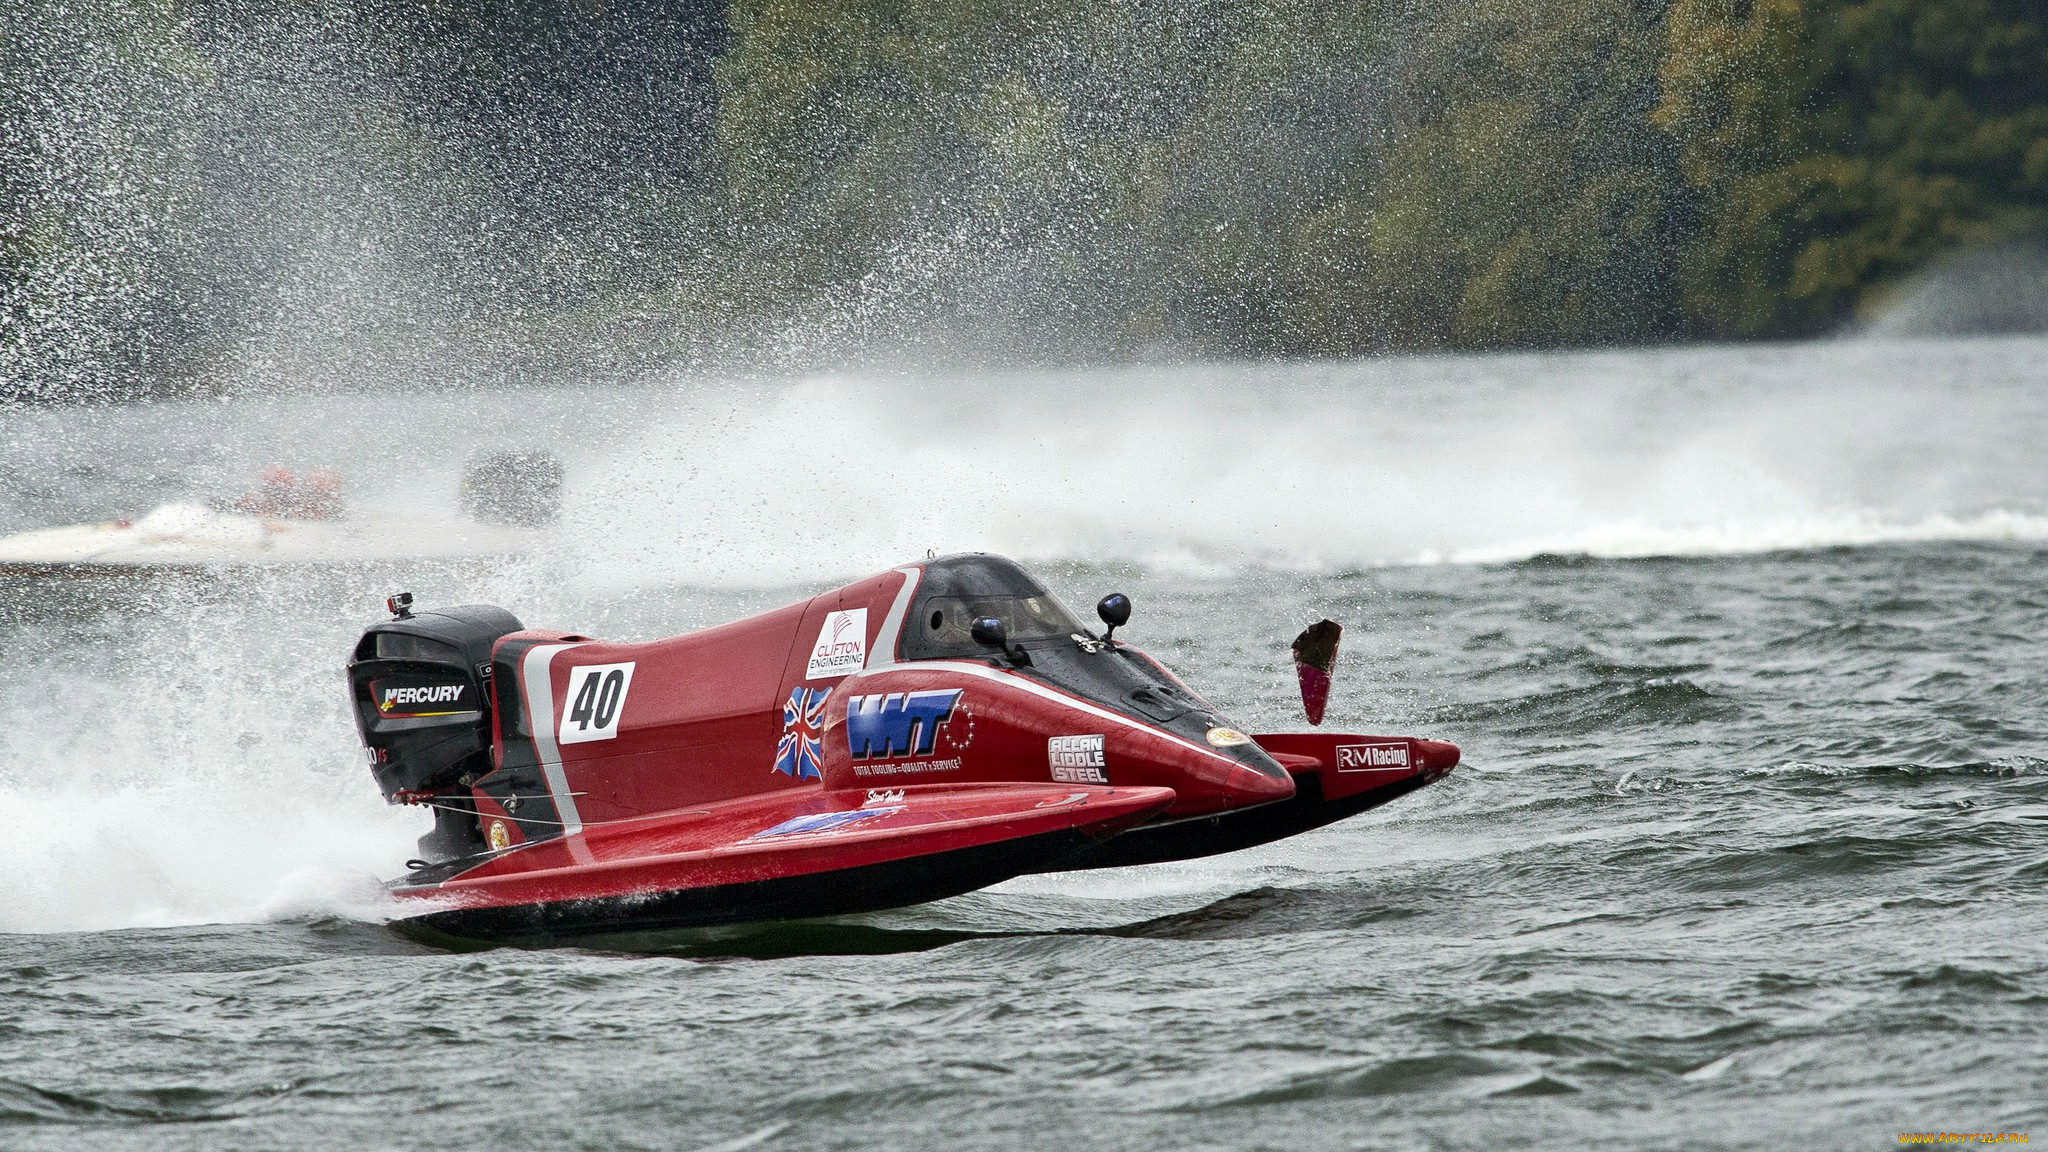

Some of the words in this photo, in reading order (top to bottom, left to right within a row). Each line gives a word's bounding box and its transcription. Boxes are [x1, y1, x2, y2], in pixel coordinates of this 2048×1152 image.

[817, 641, 861, 657] CLIFTON
[810, 654, 862, 668] ENGINEERING
[384, 685, 464, 704] MERCURY
[570, 669, 624, 731] 40
[1051, 738, 1102, 751] ALLAN
[1051, 751, 1105, 766] LIDDLE
[1372, 747, 1407, 766] Racing
[853, 766, 872, 776] TOTAL
[1055, 767, 1108, 782] STEEL
